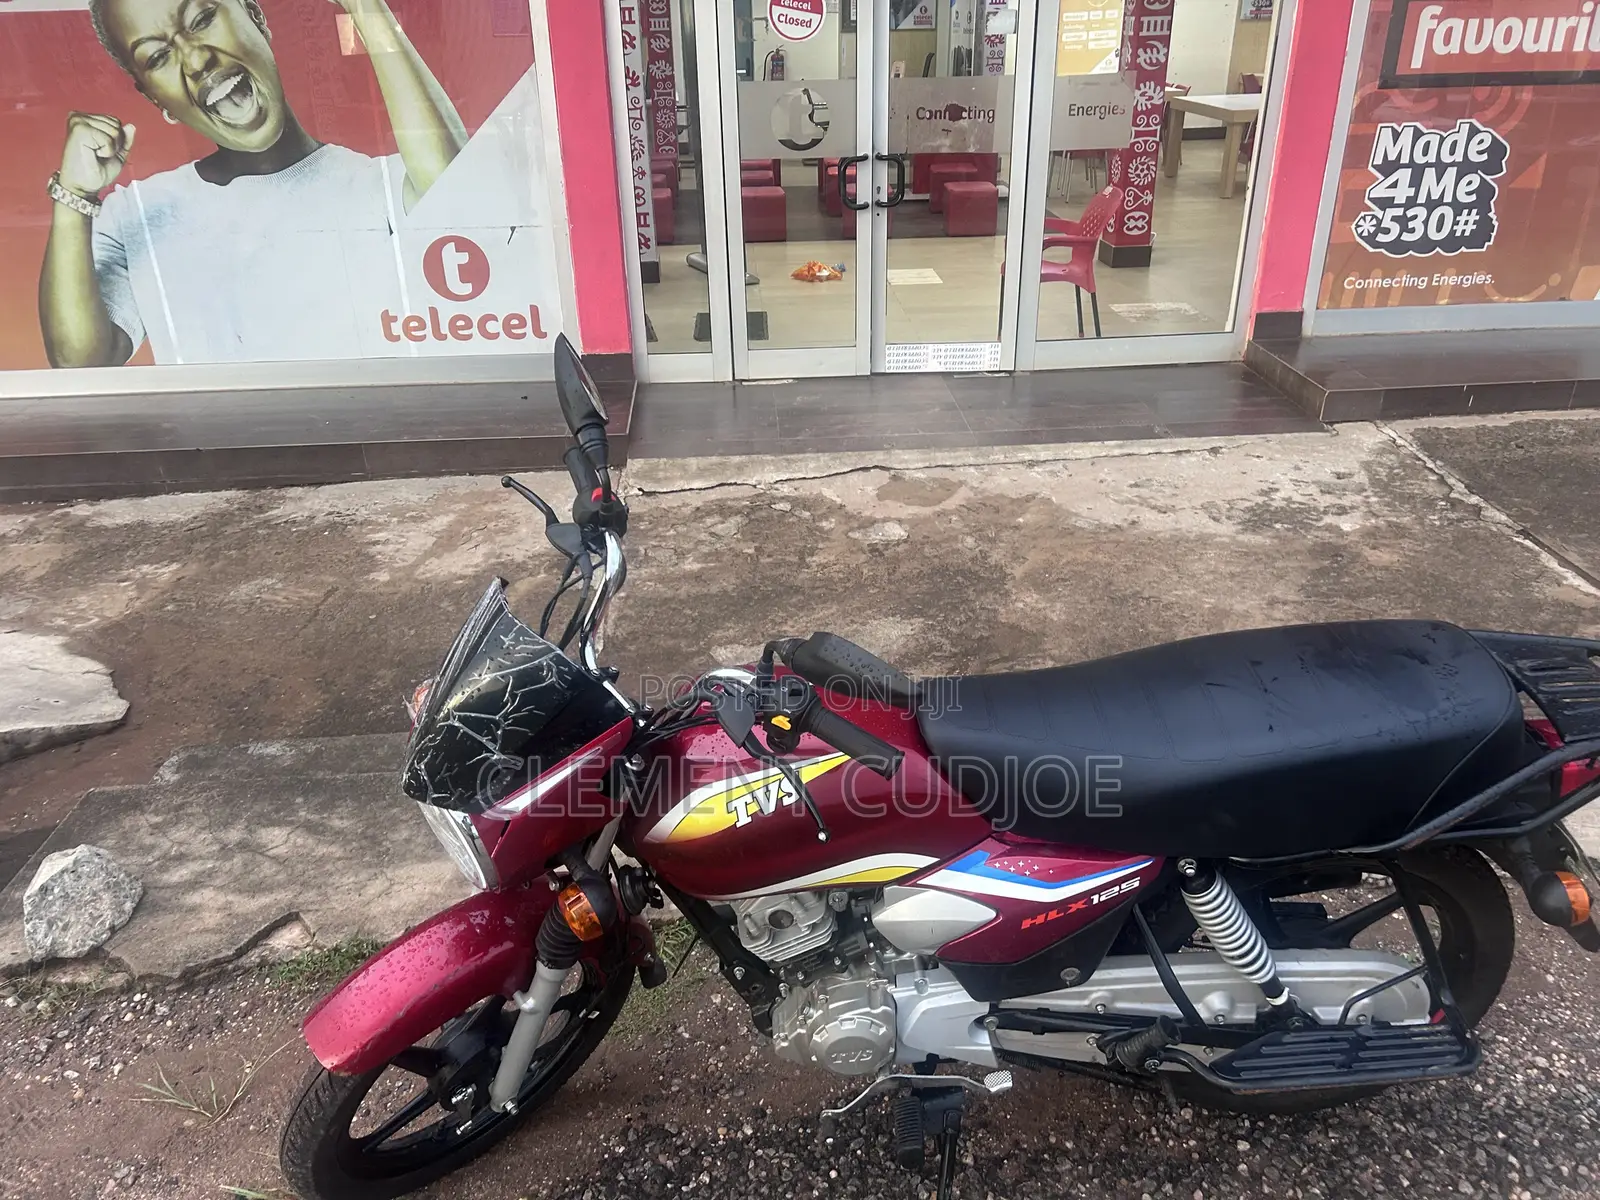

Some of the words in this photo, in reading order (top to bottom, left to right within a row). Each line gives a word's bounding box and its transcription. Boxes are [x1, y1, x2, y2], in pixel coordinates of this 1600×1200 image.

[777, 13, 812, 28] Closed
[916, 105, 995, 123] Conncting
[1068, 101, 1126, 120] Energies
[1373, 123, 1492, 165] Made
[1369, 168, 1415, 204] 4
[1416, 167, 1481, 204] Me
[1343, 275, 1429, 290] Connecting
[1431, 271, 1495, 288] Energies.
[380, 304, 548, 343] telecel
[726, 771, 802, 829] TVS
[1021, 898, 1088, 930] HLX
[1090, 876, 1141, 905] 125
[830, 1049, 874, 1064] TVS
